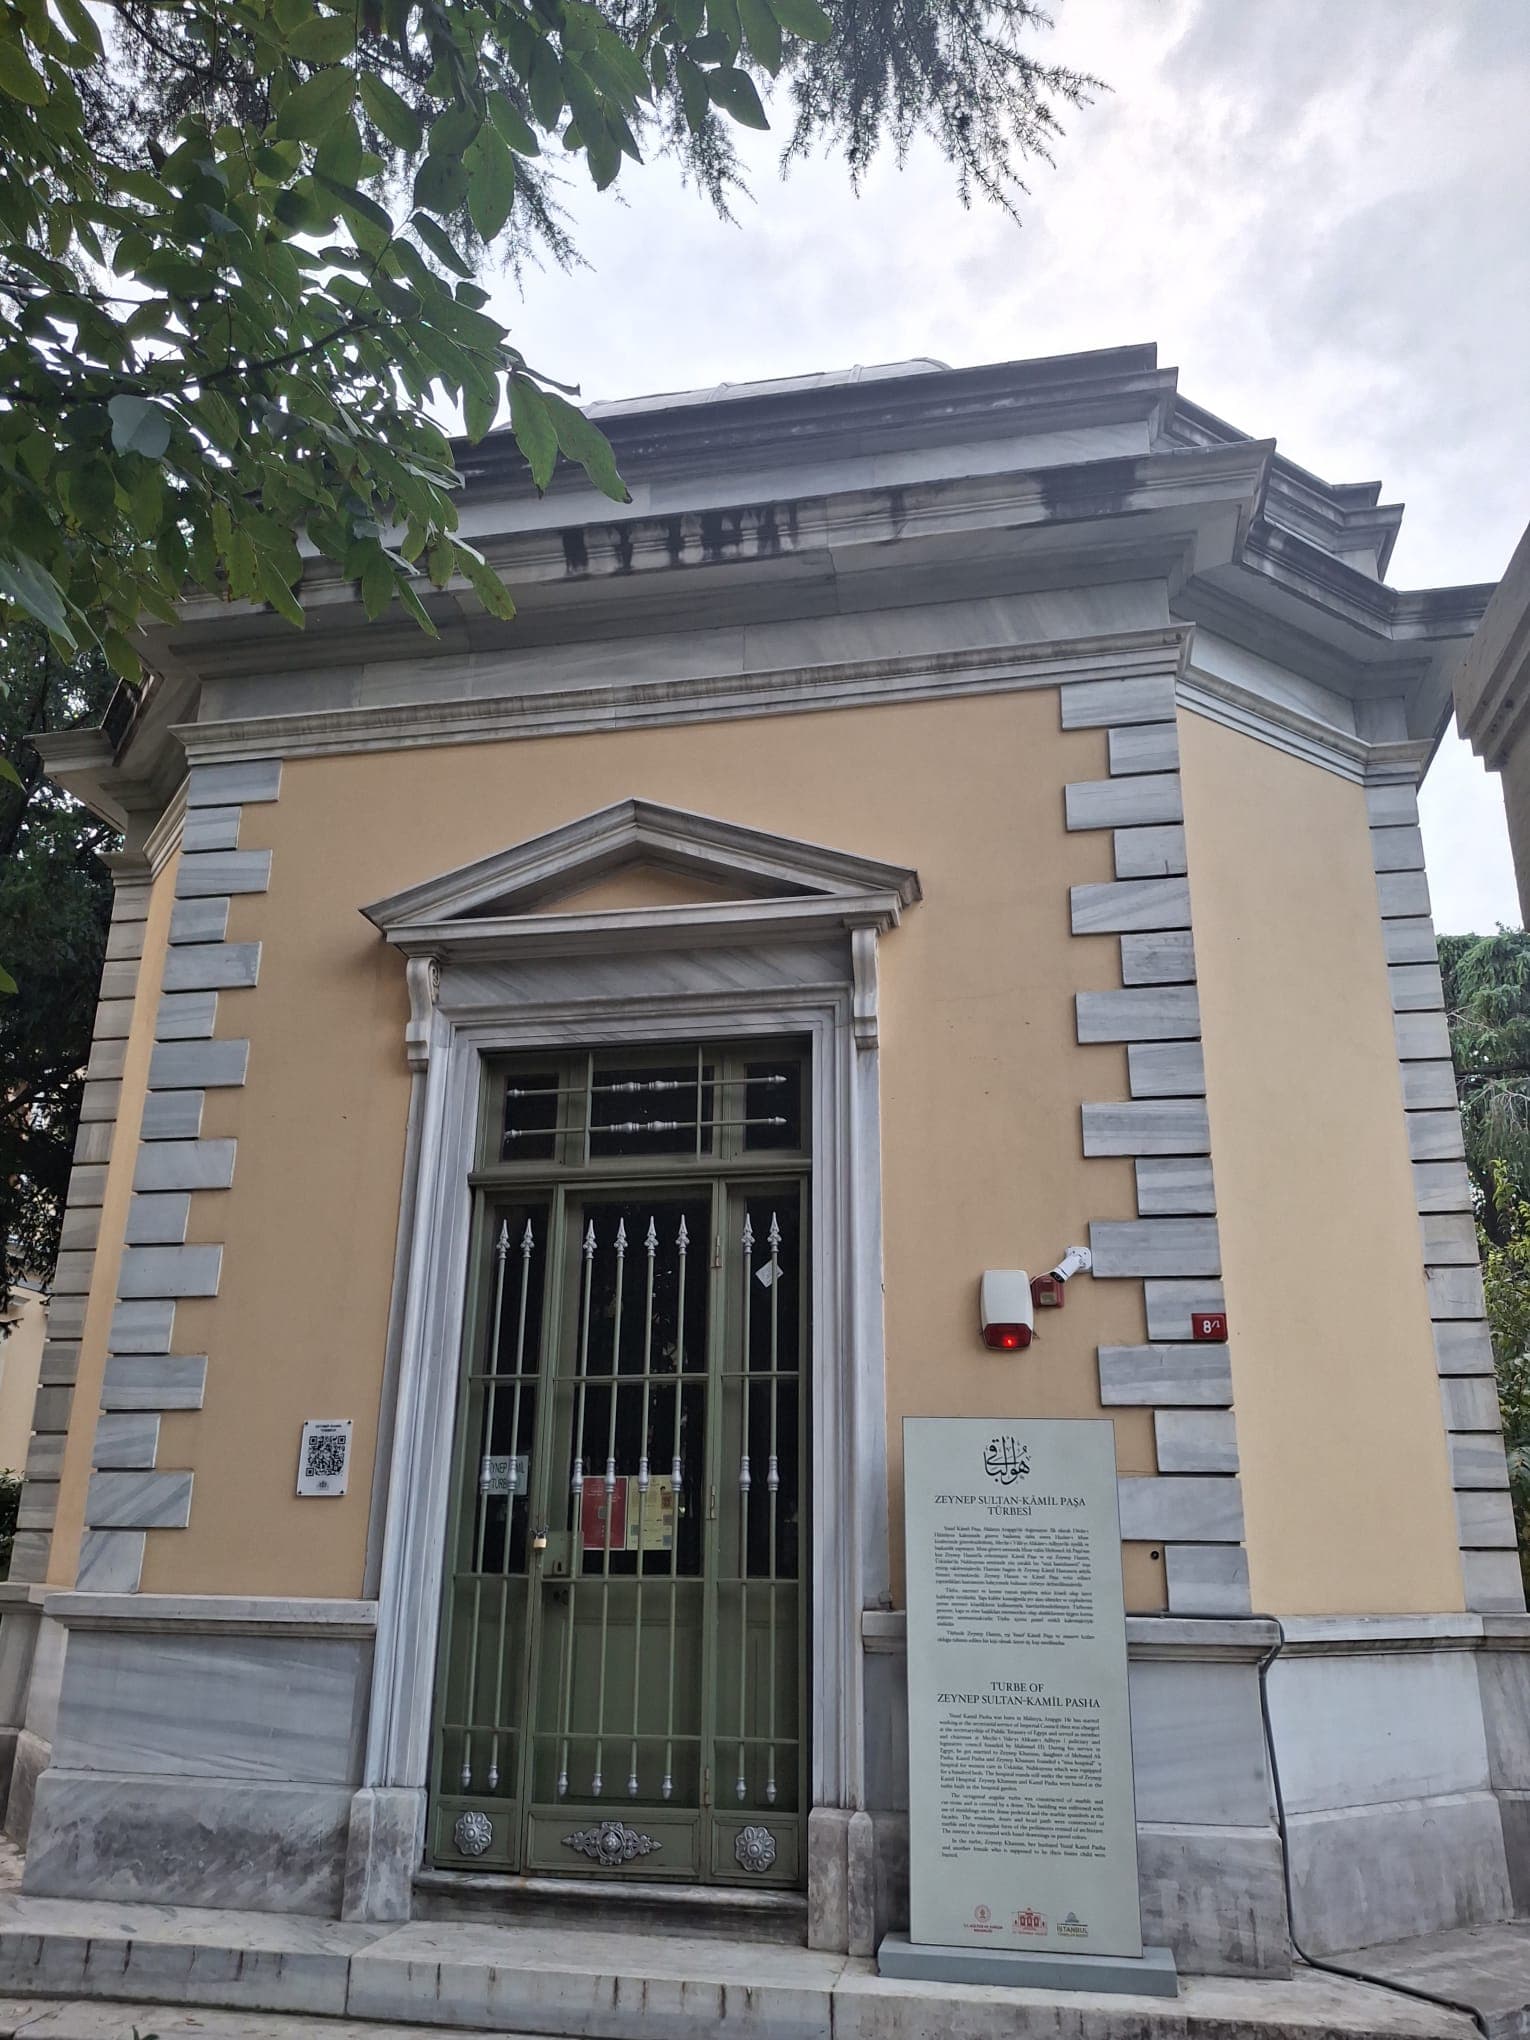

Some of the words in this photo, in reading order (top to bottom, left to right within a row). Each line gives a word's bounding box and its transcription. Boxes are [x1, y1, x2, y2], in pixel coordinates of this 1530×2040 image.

[935, 1495, 977, 1504] ZEYNEP
[1060, 1496, 1087, 1508] PAŞA
[987, 1505, 1032, 1516] TÜRBESİ
[990, 1681, 1027, 1692] TURBE
[1029, 1682, 1045, 1693] OF
[937, 1693, 980, 1704] ZEYNEP
[1065, 1697, 1101, 1708] PASHA
